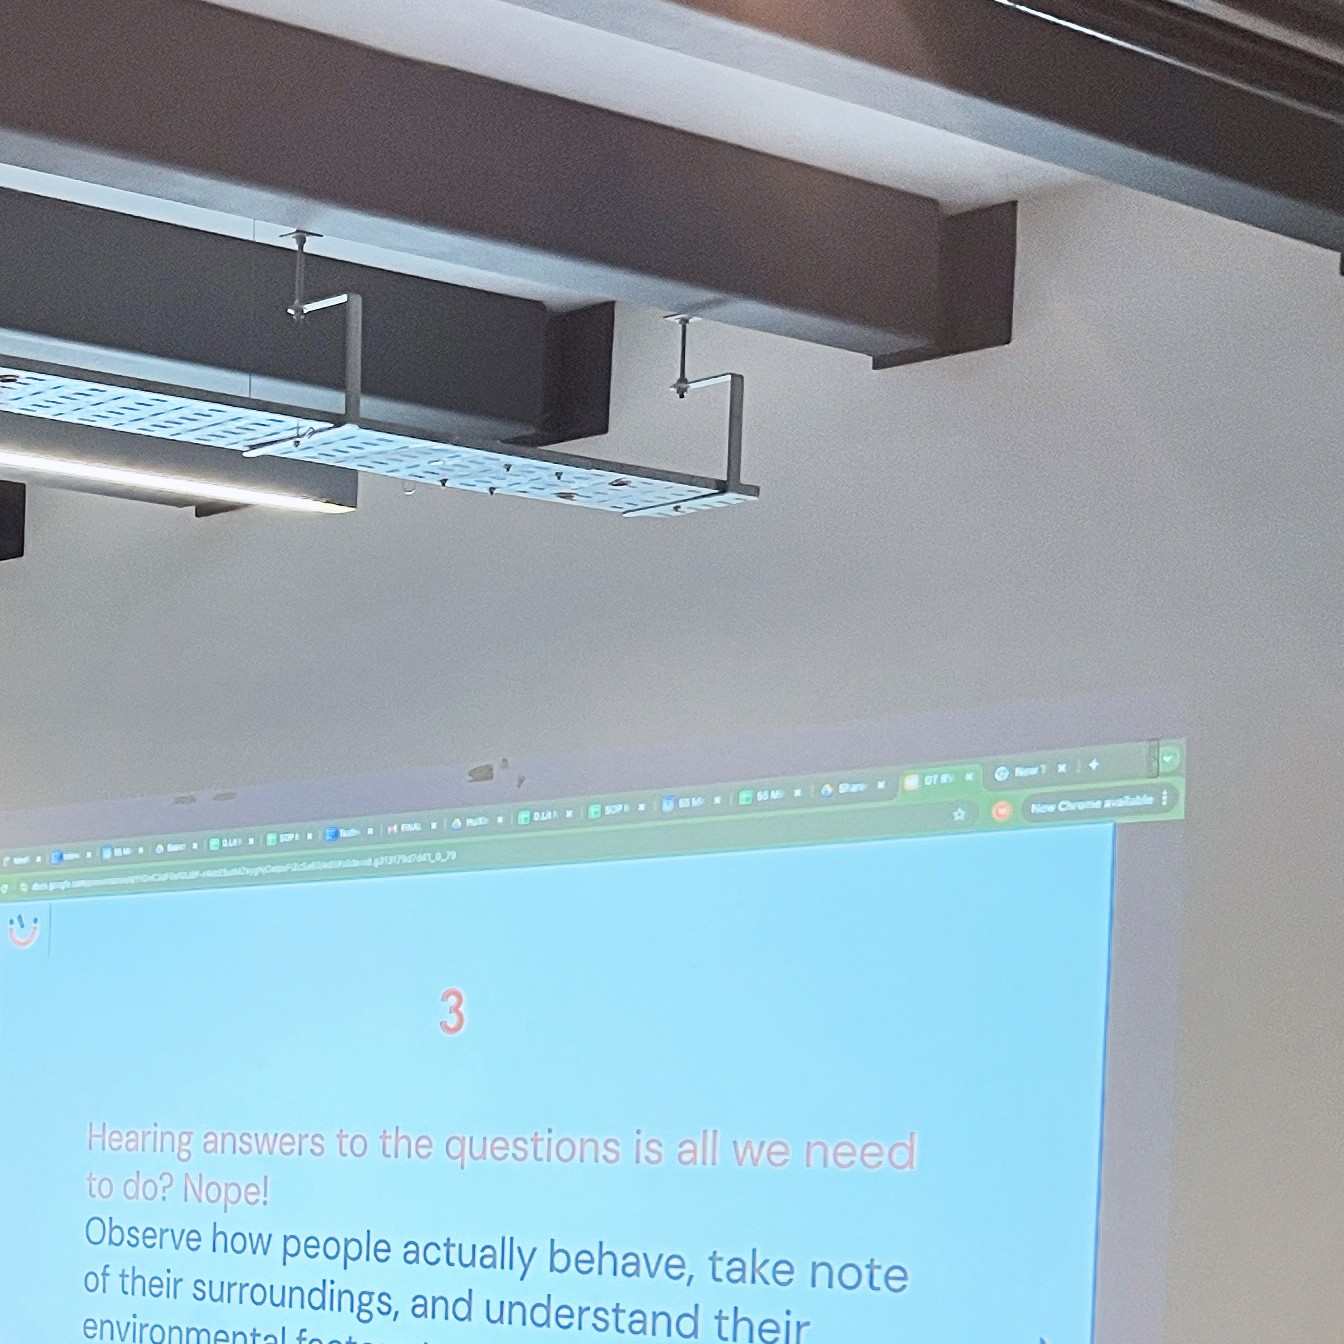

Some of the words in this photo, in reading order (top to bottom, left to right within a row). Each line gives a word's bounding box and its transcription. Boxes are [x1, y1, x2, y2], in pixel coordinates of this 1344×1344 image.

[439, 987, 465, 1035] 3
[87, 1121, 194, 1162] Hearing
[202, 1128, 325, 1157] answers
[336, 1128, 368, 1158] to
[380, 1125, 433, 1160] the
[445, 1127, 621, 1170] questions
[634, 1128, 664, 1166] is
[677, 1129, 719, 1167] all
[732, 1138, 790, 1168] we
[805, 1131, 917, 1170] need
[86, 1172, 113, 1199] to
[123, 1170, 174, 1202] do?
[183, 1173, 269, 1213] Nope!
[85, 1216, 202, 1252] Observe
[212, 1222, 273, 1256] how
[282, 1230, 392, 1270] people
[403, 1235, 538, 1282] actually
[549, 1238, 695, 1287] behave,
[707, 1248, 795, 1287] take
[811, 1257, 910, 1293] note
[83, 1263, 111, 1295] of
[119, 1265, 184, 1300] their
[192, 1279, 400, 1324] surroundings,
[411, 1288, 473, 1323] and
[485, 1294, 700, 1340] understand
